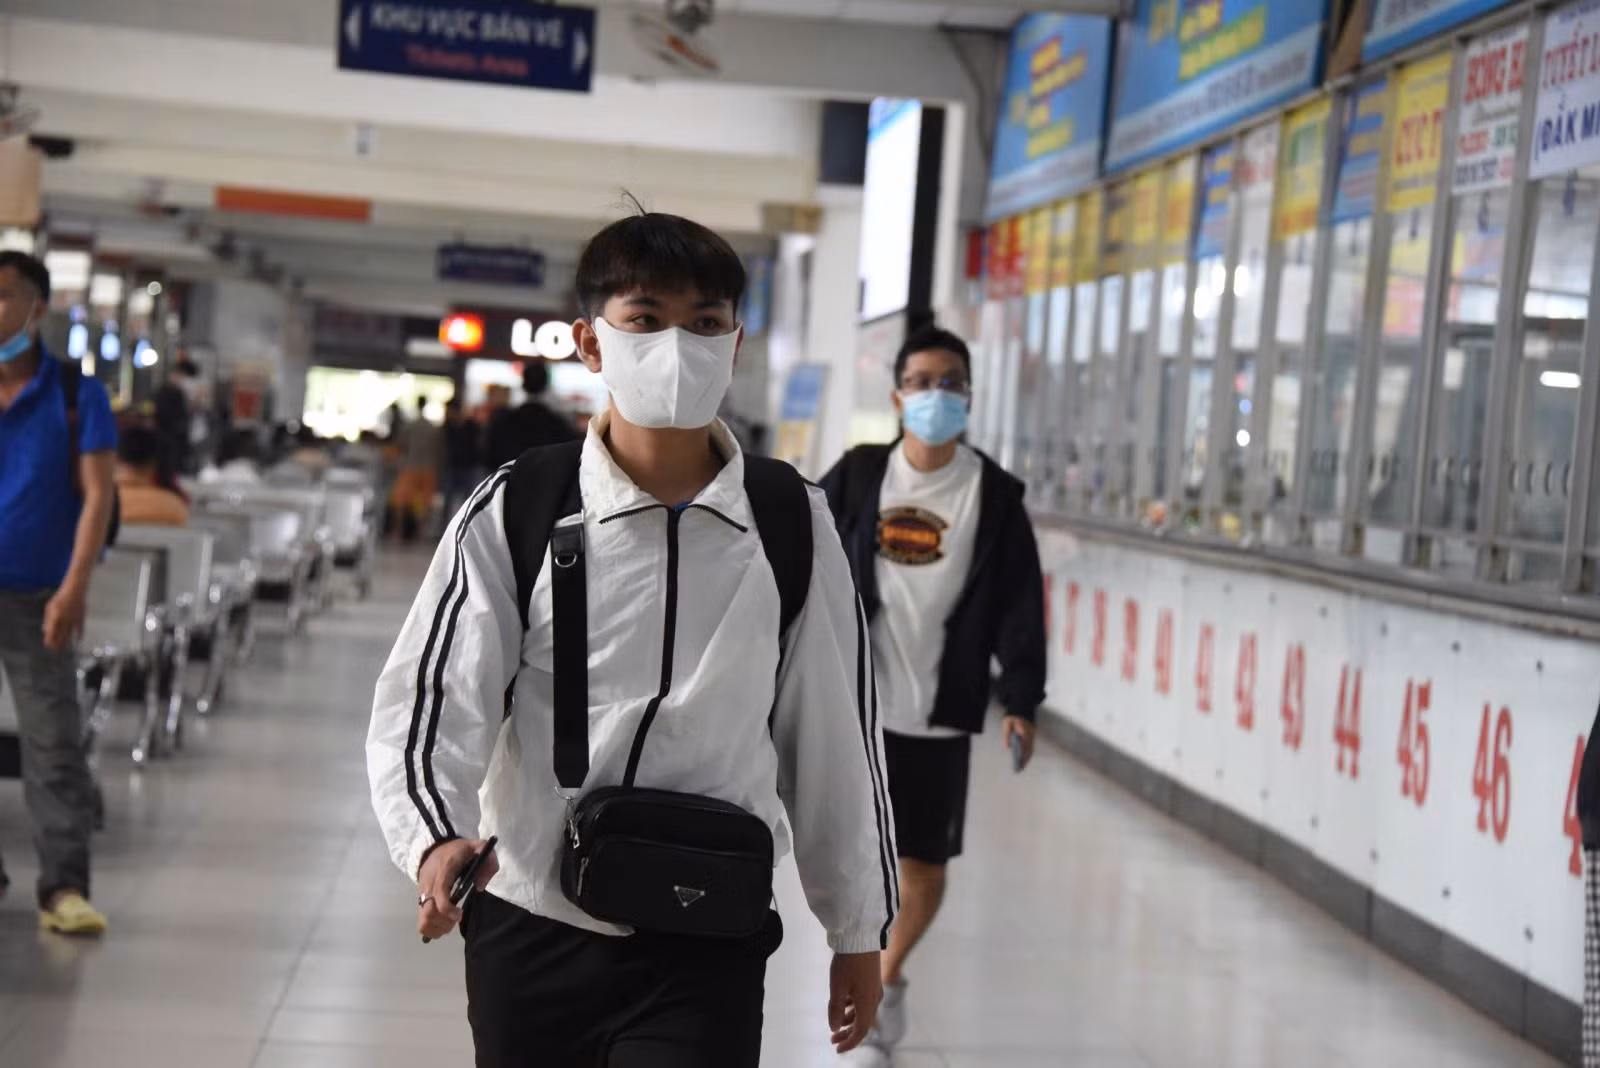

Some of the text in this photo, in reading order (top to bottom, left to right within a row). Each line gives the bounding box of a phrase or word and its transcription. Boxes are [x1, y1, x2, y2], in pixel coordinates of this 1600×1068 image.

[369, 3, 422, 33] KHU
[1280, 642, 1305, 752] 43
[1333, 664, 1362, 782] 44
[1396, 677, 1431, 808] 45
[1473, 701, 1512, 844] 46
[1563, 732, 1586, 878] 4
